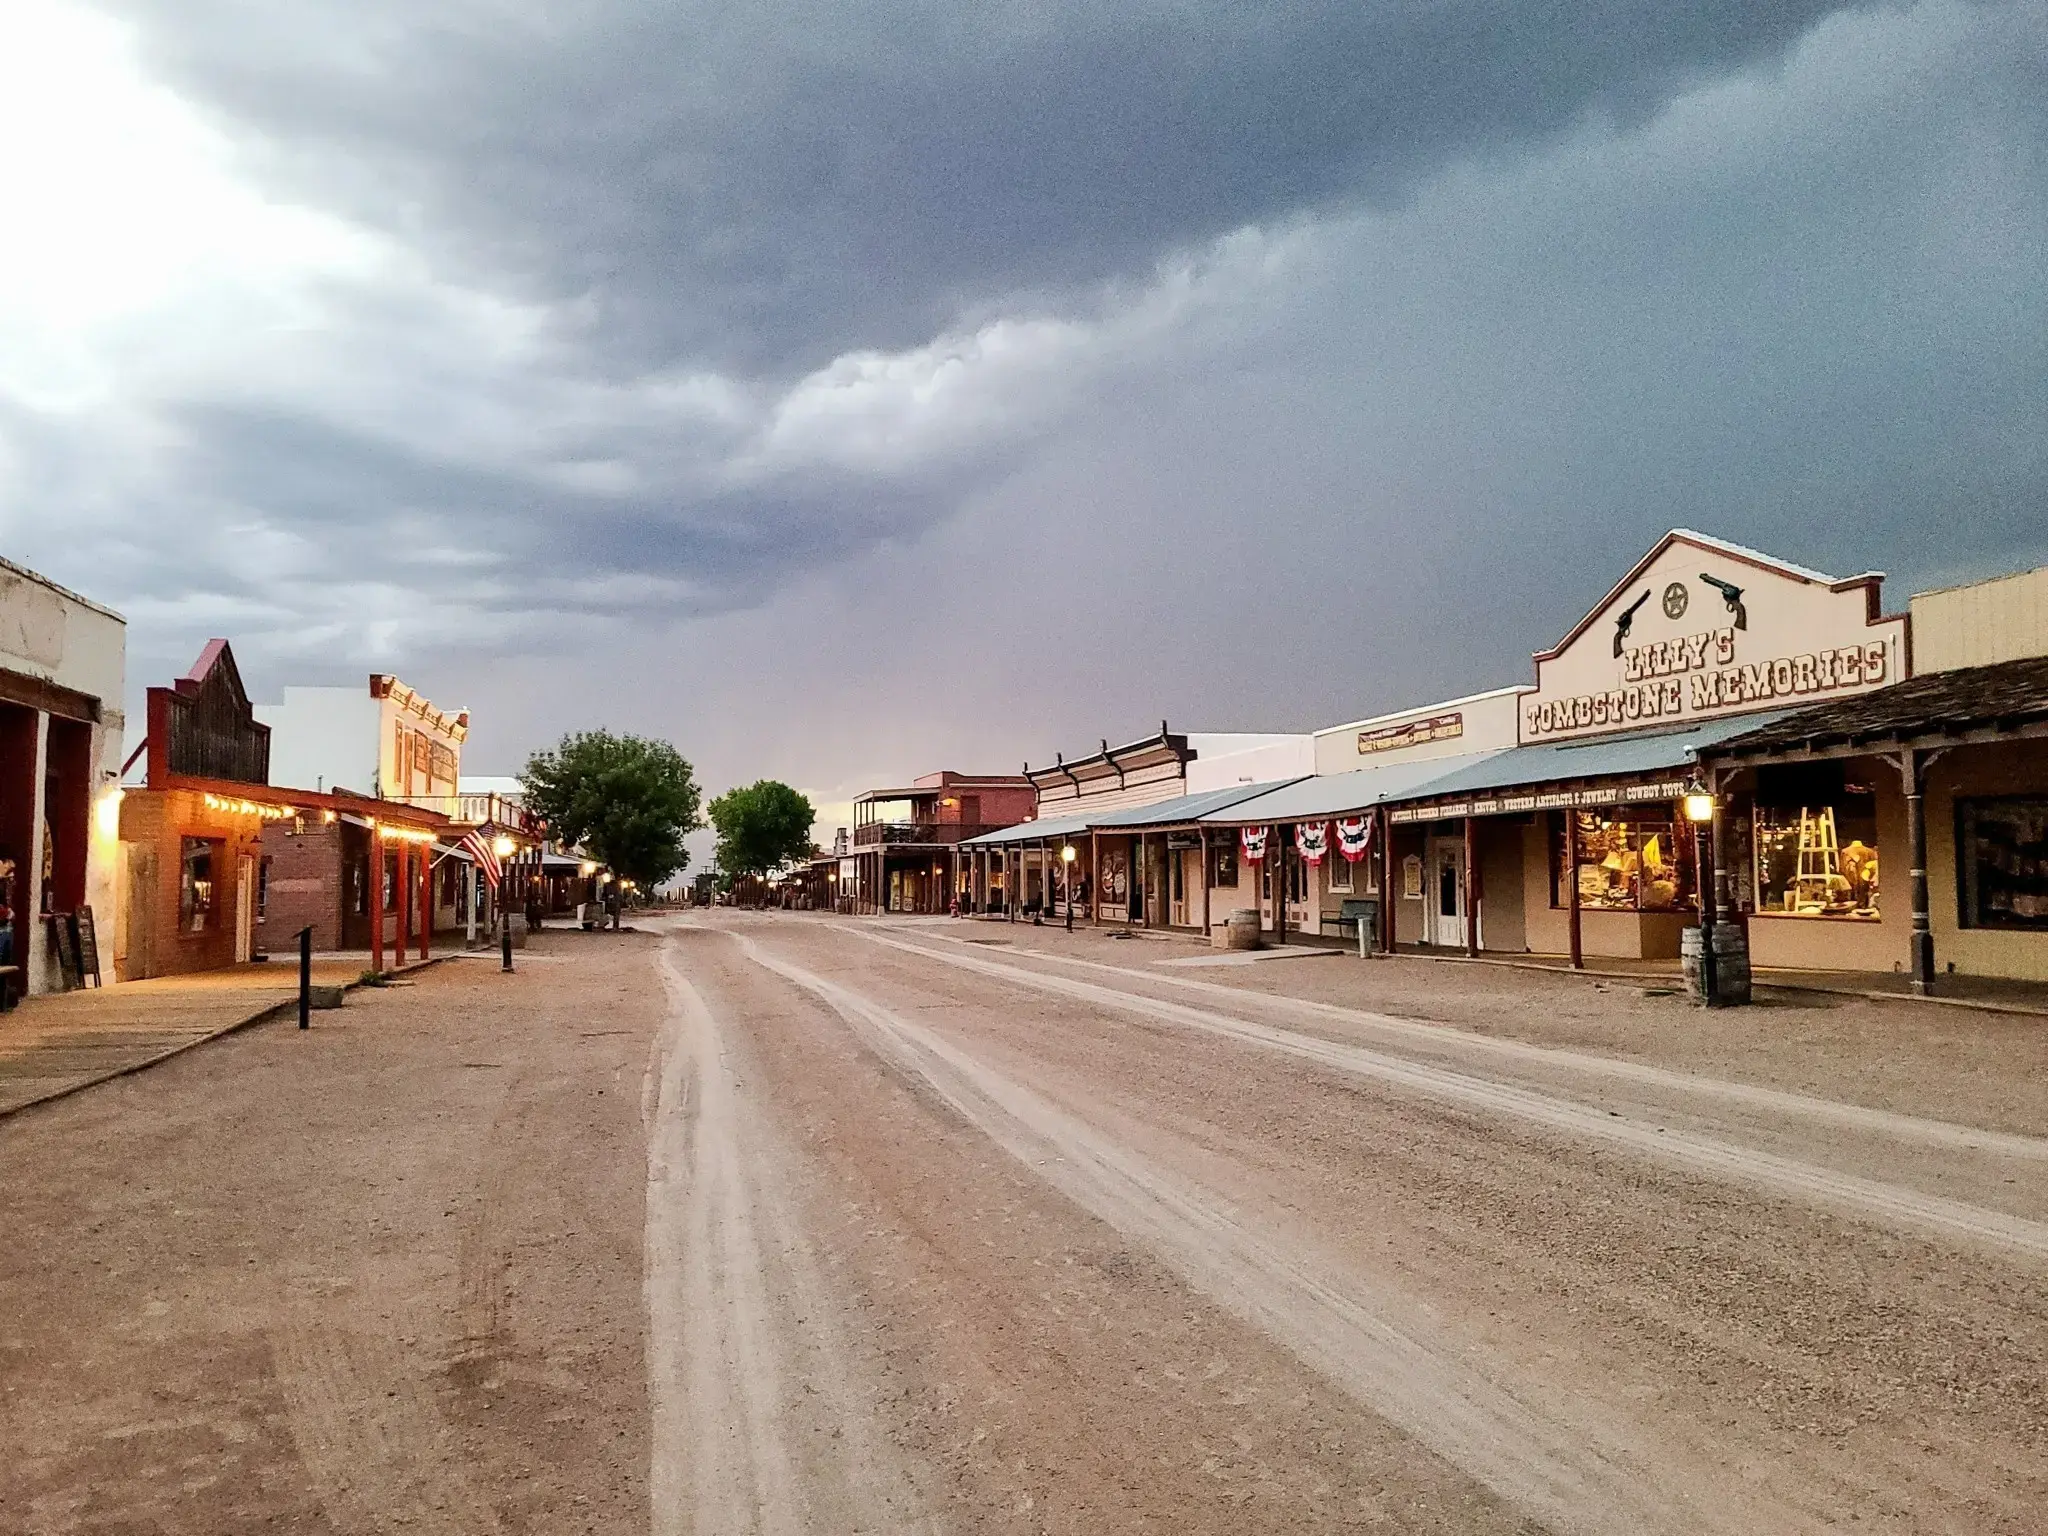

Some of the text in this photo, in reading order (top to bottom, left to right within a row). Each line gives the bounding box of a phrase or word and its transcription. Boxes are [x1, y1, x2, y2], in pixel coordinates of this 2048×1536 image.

[1624, 626, 1736, 682] LILLY'S
[1526, 640, 1887, 735] TOMBSTONE MEMORIES
[1503, 796, 1535, 810] WESTERN
[1535, 792, 1573, 808] ARTIFACTS
[1580, 788, 1617, 804] JEWELRY
[1626, 784, 1660, 800] COWBOY
[1661, 781, 1685, 797] TOYS
